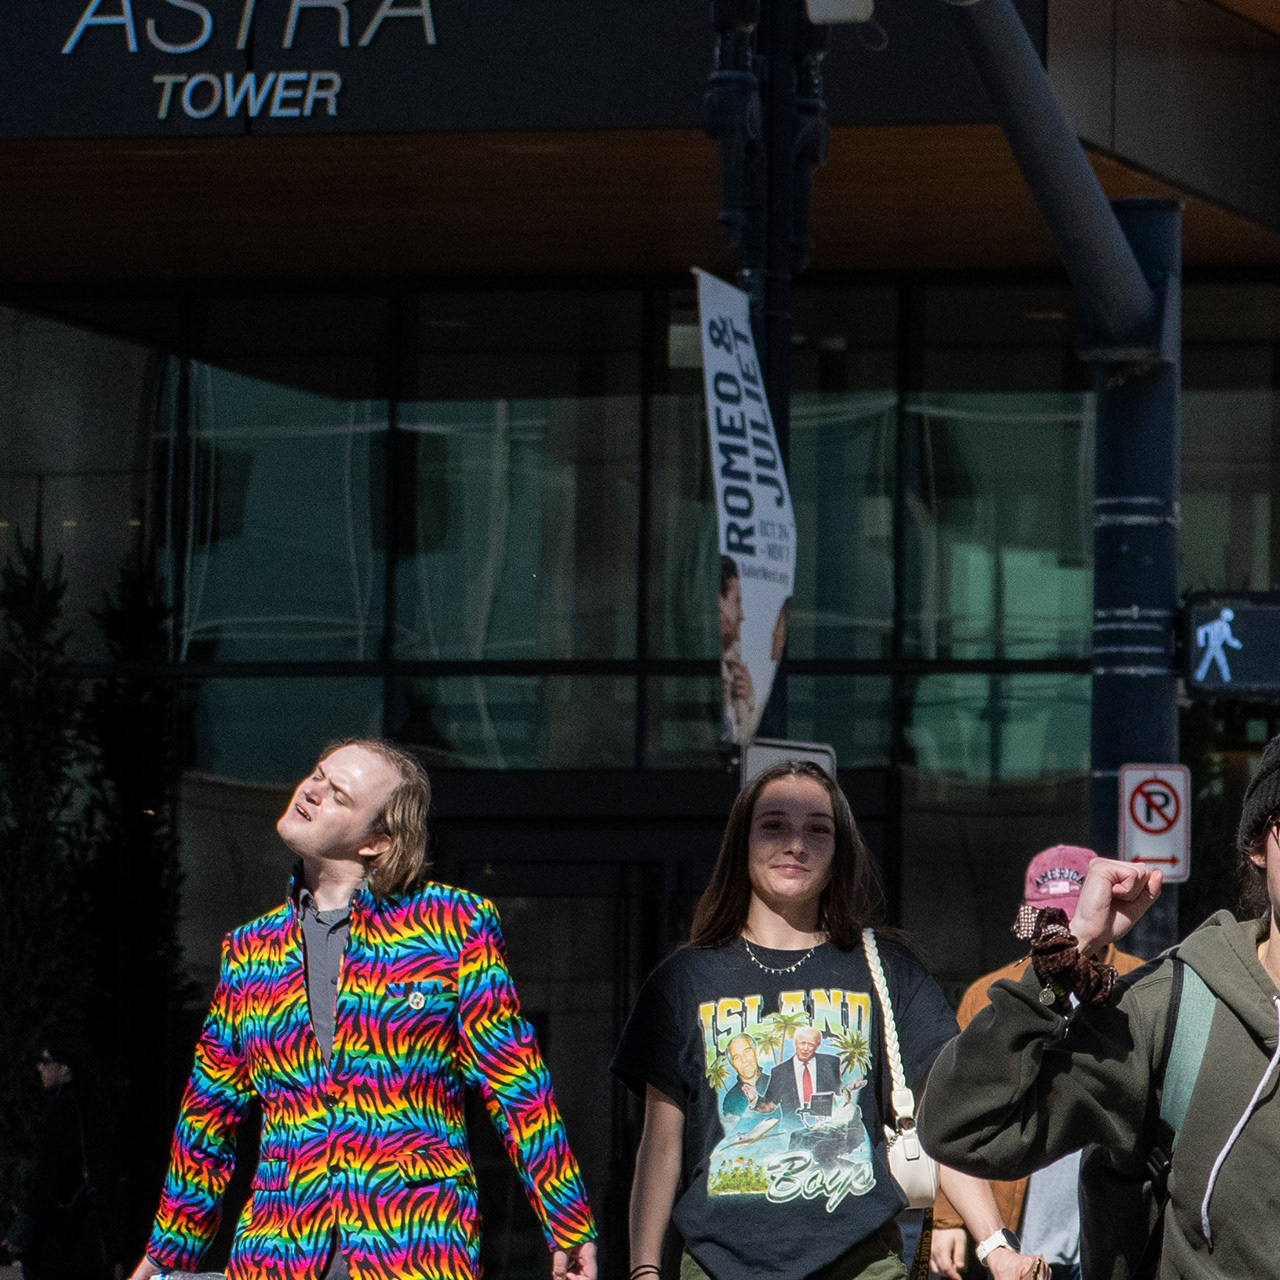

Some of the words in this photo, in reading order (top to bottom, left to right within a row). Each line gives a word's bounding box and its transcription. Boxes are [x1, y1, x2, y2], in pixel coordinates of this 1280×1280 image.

[152, 70, 343, 120] TOWER
[708, 315, 733, 355] &
[728, 317, 785, 509] JULIET
[713, 371, 757, 557] ROMEO
[1034, 868, 1086, 890] AMERICA
[697, 988, 874, 1069] ISLAND
[766, 1151, 877, 1214] Boys
